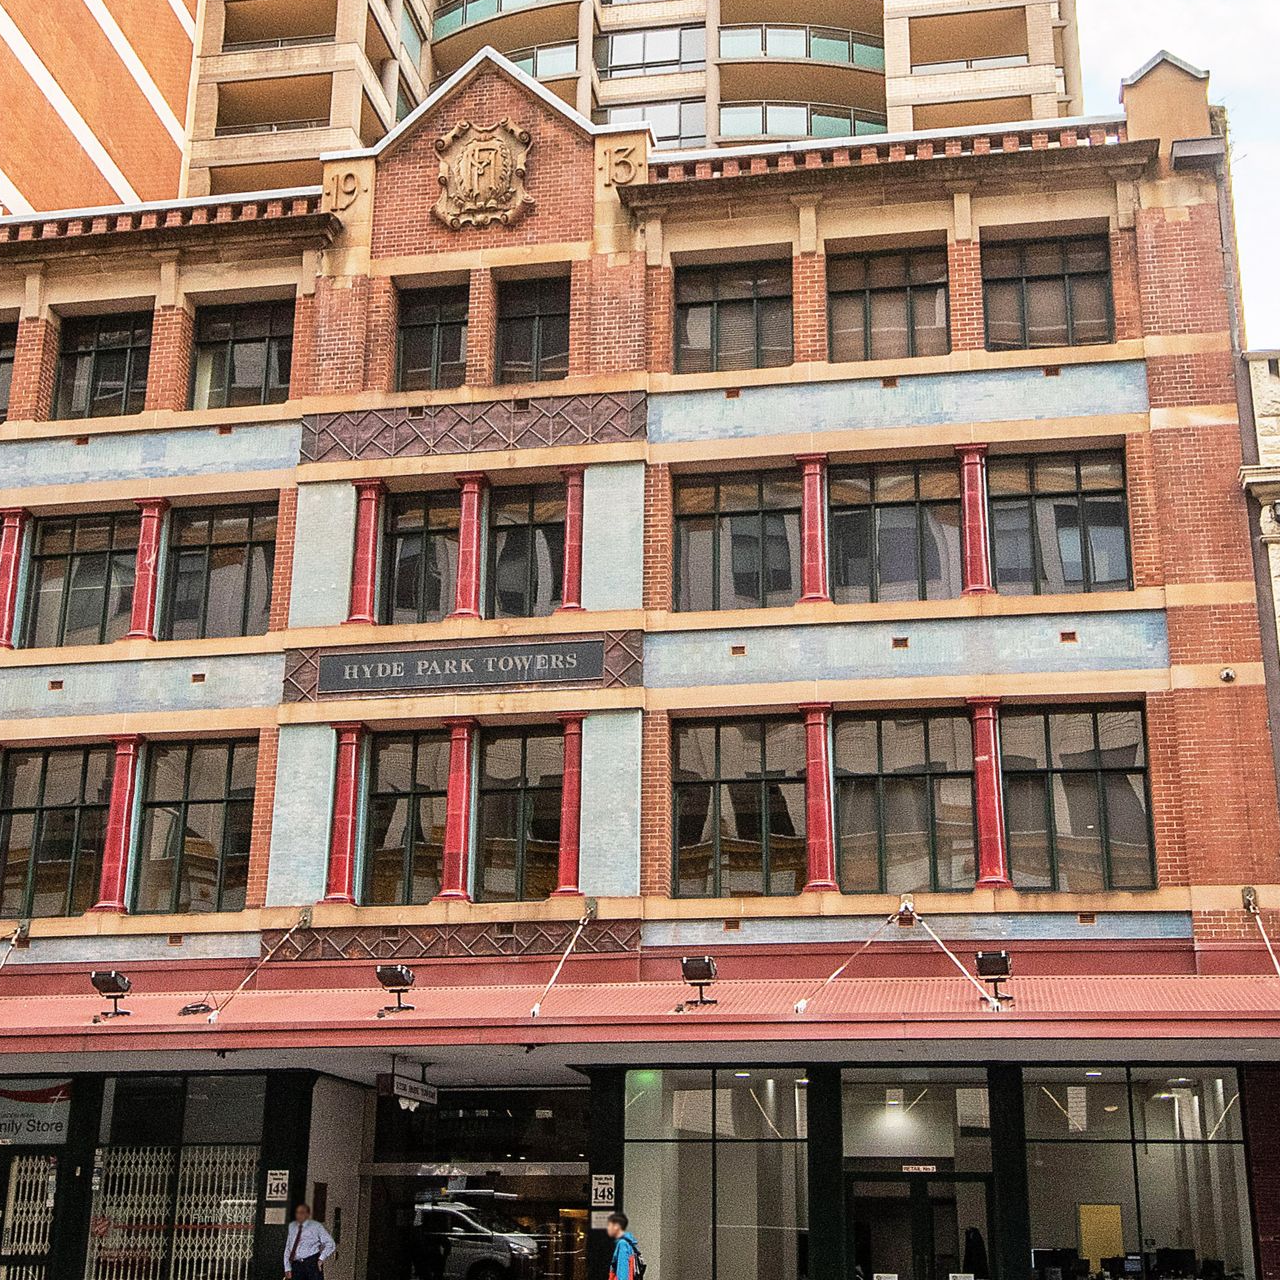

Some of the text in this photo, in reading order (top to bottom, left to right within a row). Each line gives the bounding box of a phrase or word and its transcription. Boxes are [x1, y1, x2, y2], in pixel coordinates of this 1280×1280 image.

[343, 653, 578, 679] HYDE PARK TOWERS
[26, 1119, 64, 1133] Store
[268, 1182, 287, 1195] 148
[593, 1187, 614, 1200] 148
